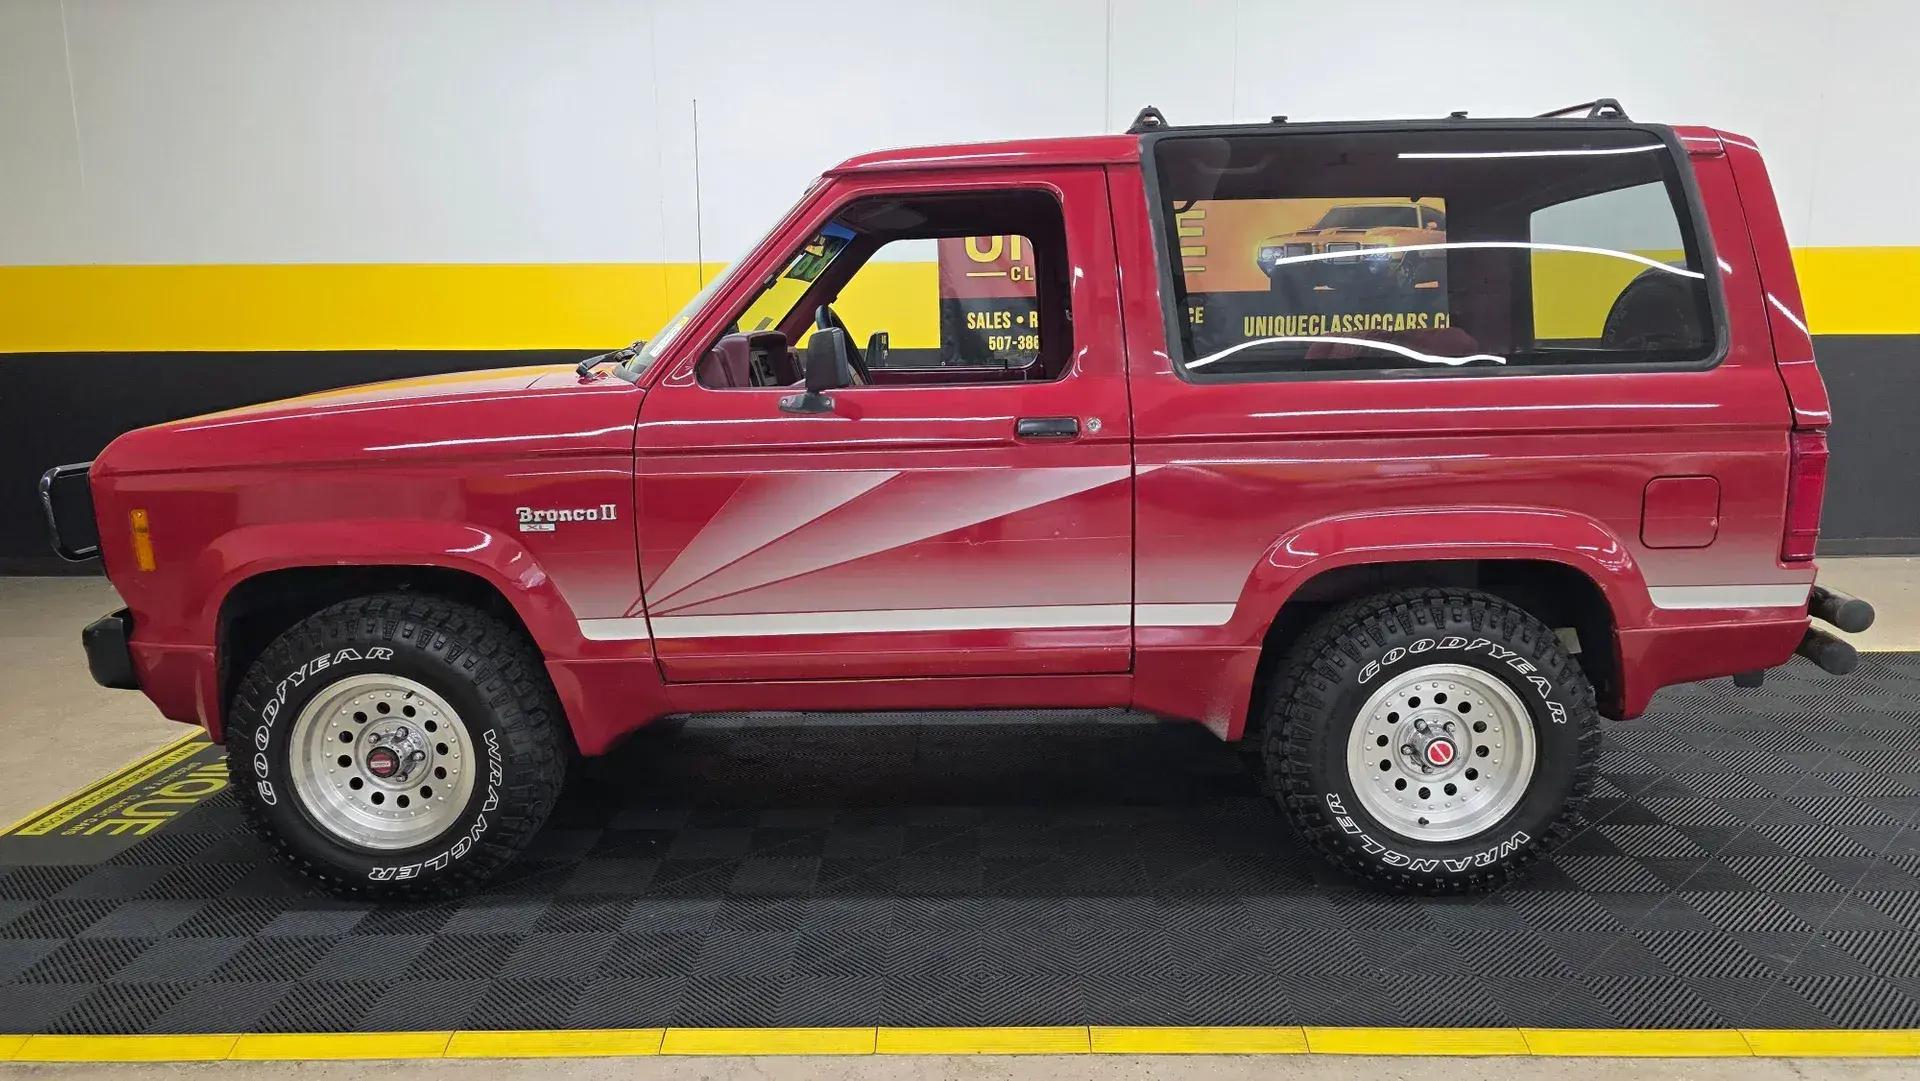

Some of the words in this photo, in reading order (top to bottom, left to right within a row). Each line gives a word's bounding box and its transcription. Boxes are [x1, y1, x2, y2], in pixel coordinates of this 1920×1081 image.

[967, 311, 1011, 329] SALES
[515, 506, 598, 522] Bronco
[600, 504, 617, 520] II
[1358, 636, 1567, 724] GOODYEAR
[254, 647, 394, 805] GOODYEAR
[61, 818, 98, 836] CARS
[368, 729, 502, 880] WRANGLER
[1326, 793, 1530, 872] WRANGLER
